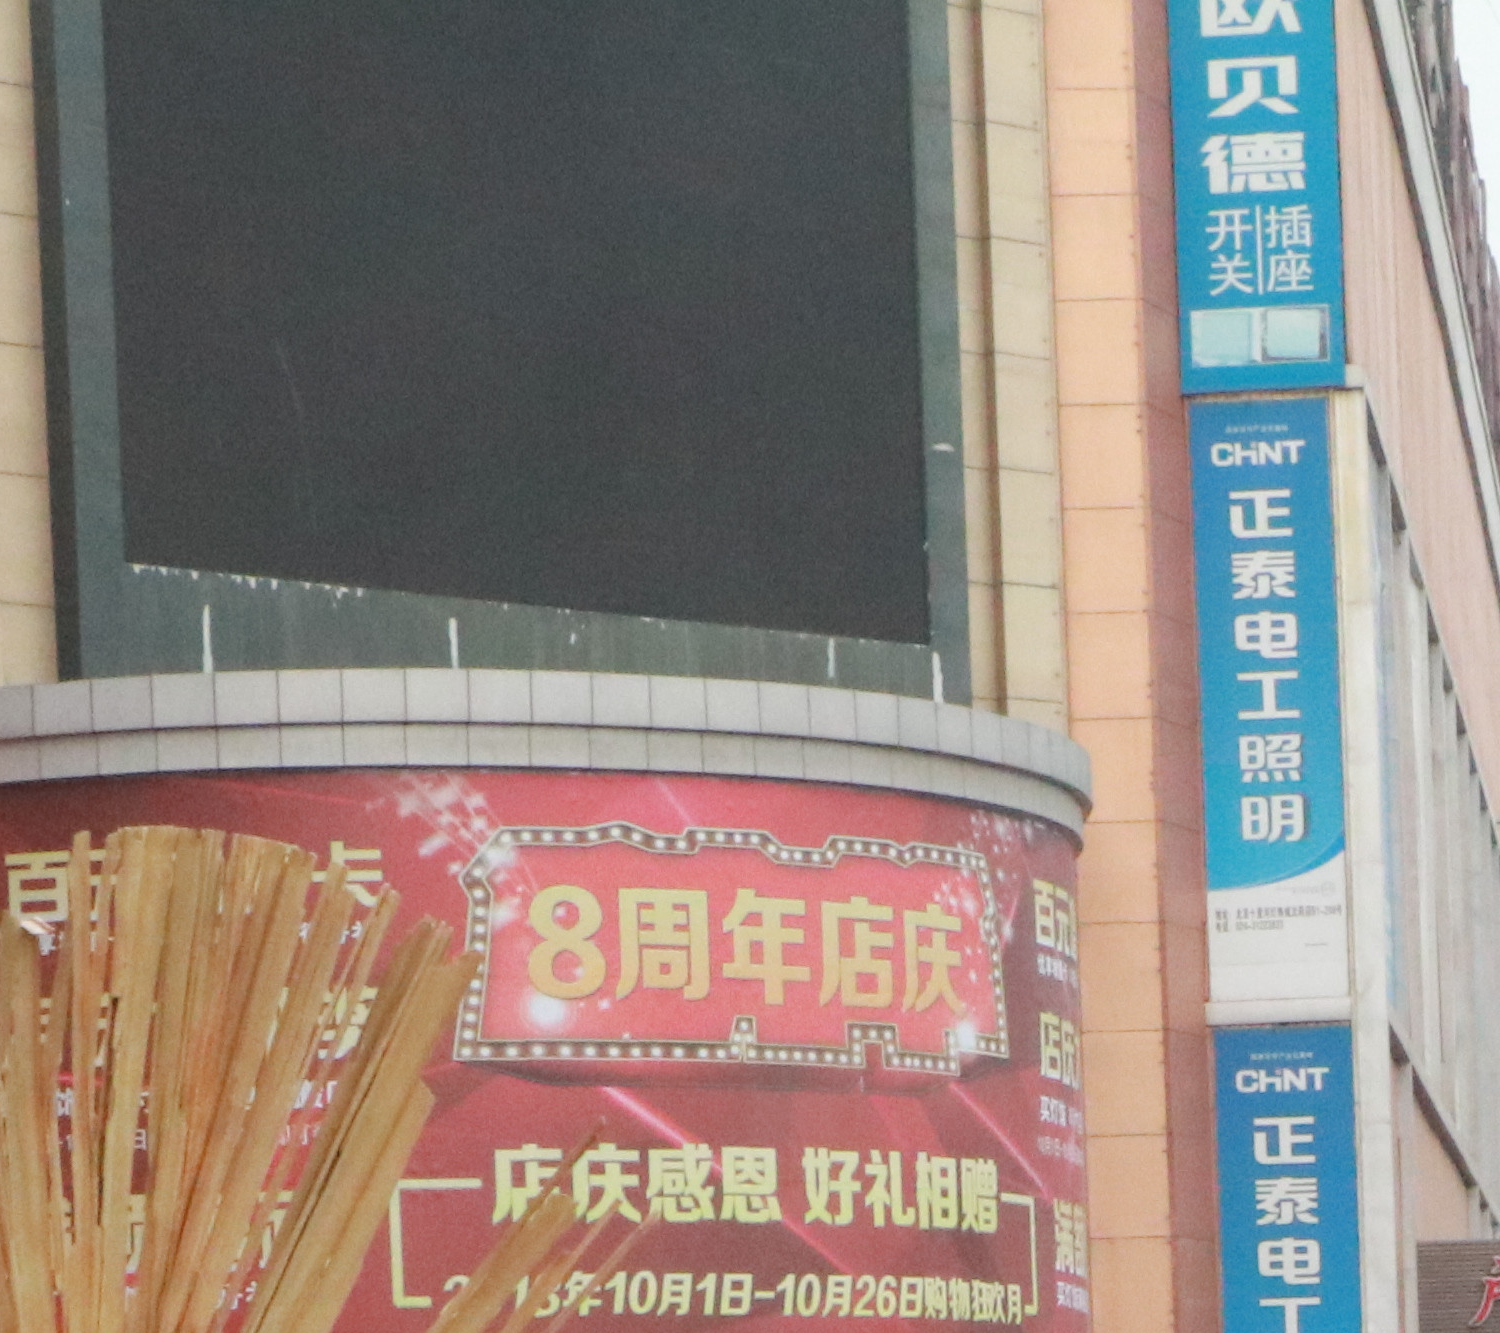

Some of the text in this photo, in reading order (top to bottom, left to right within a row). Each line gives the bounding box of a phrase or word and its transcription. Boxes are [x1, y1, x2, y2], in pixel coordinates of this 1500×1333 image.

[1205, 207, 1255, 297] 开关
[1264, 204, 1315, 293] 插座
[1228, 489, 1307, 844] 正泰电工照明
[527, 883, 967, 1016] 8周年店庆
[491, 1142, 999, 1234] 店庆感恩 好礼相赠
